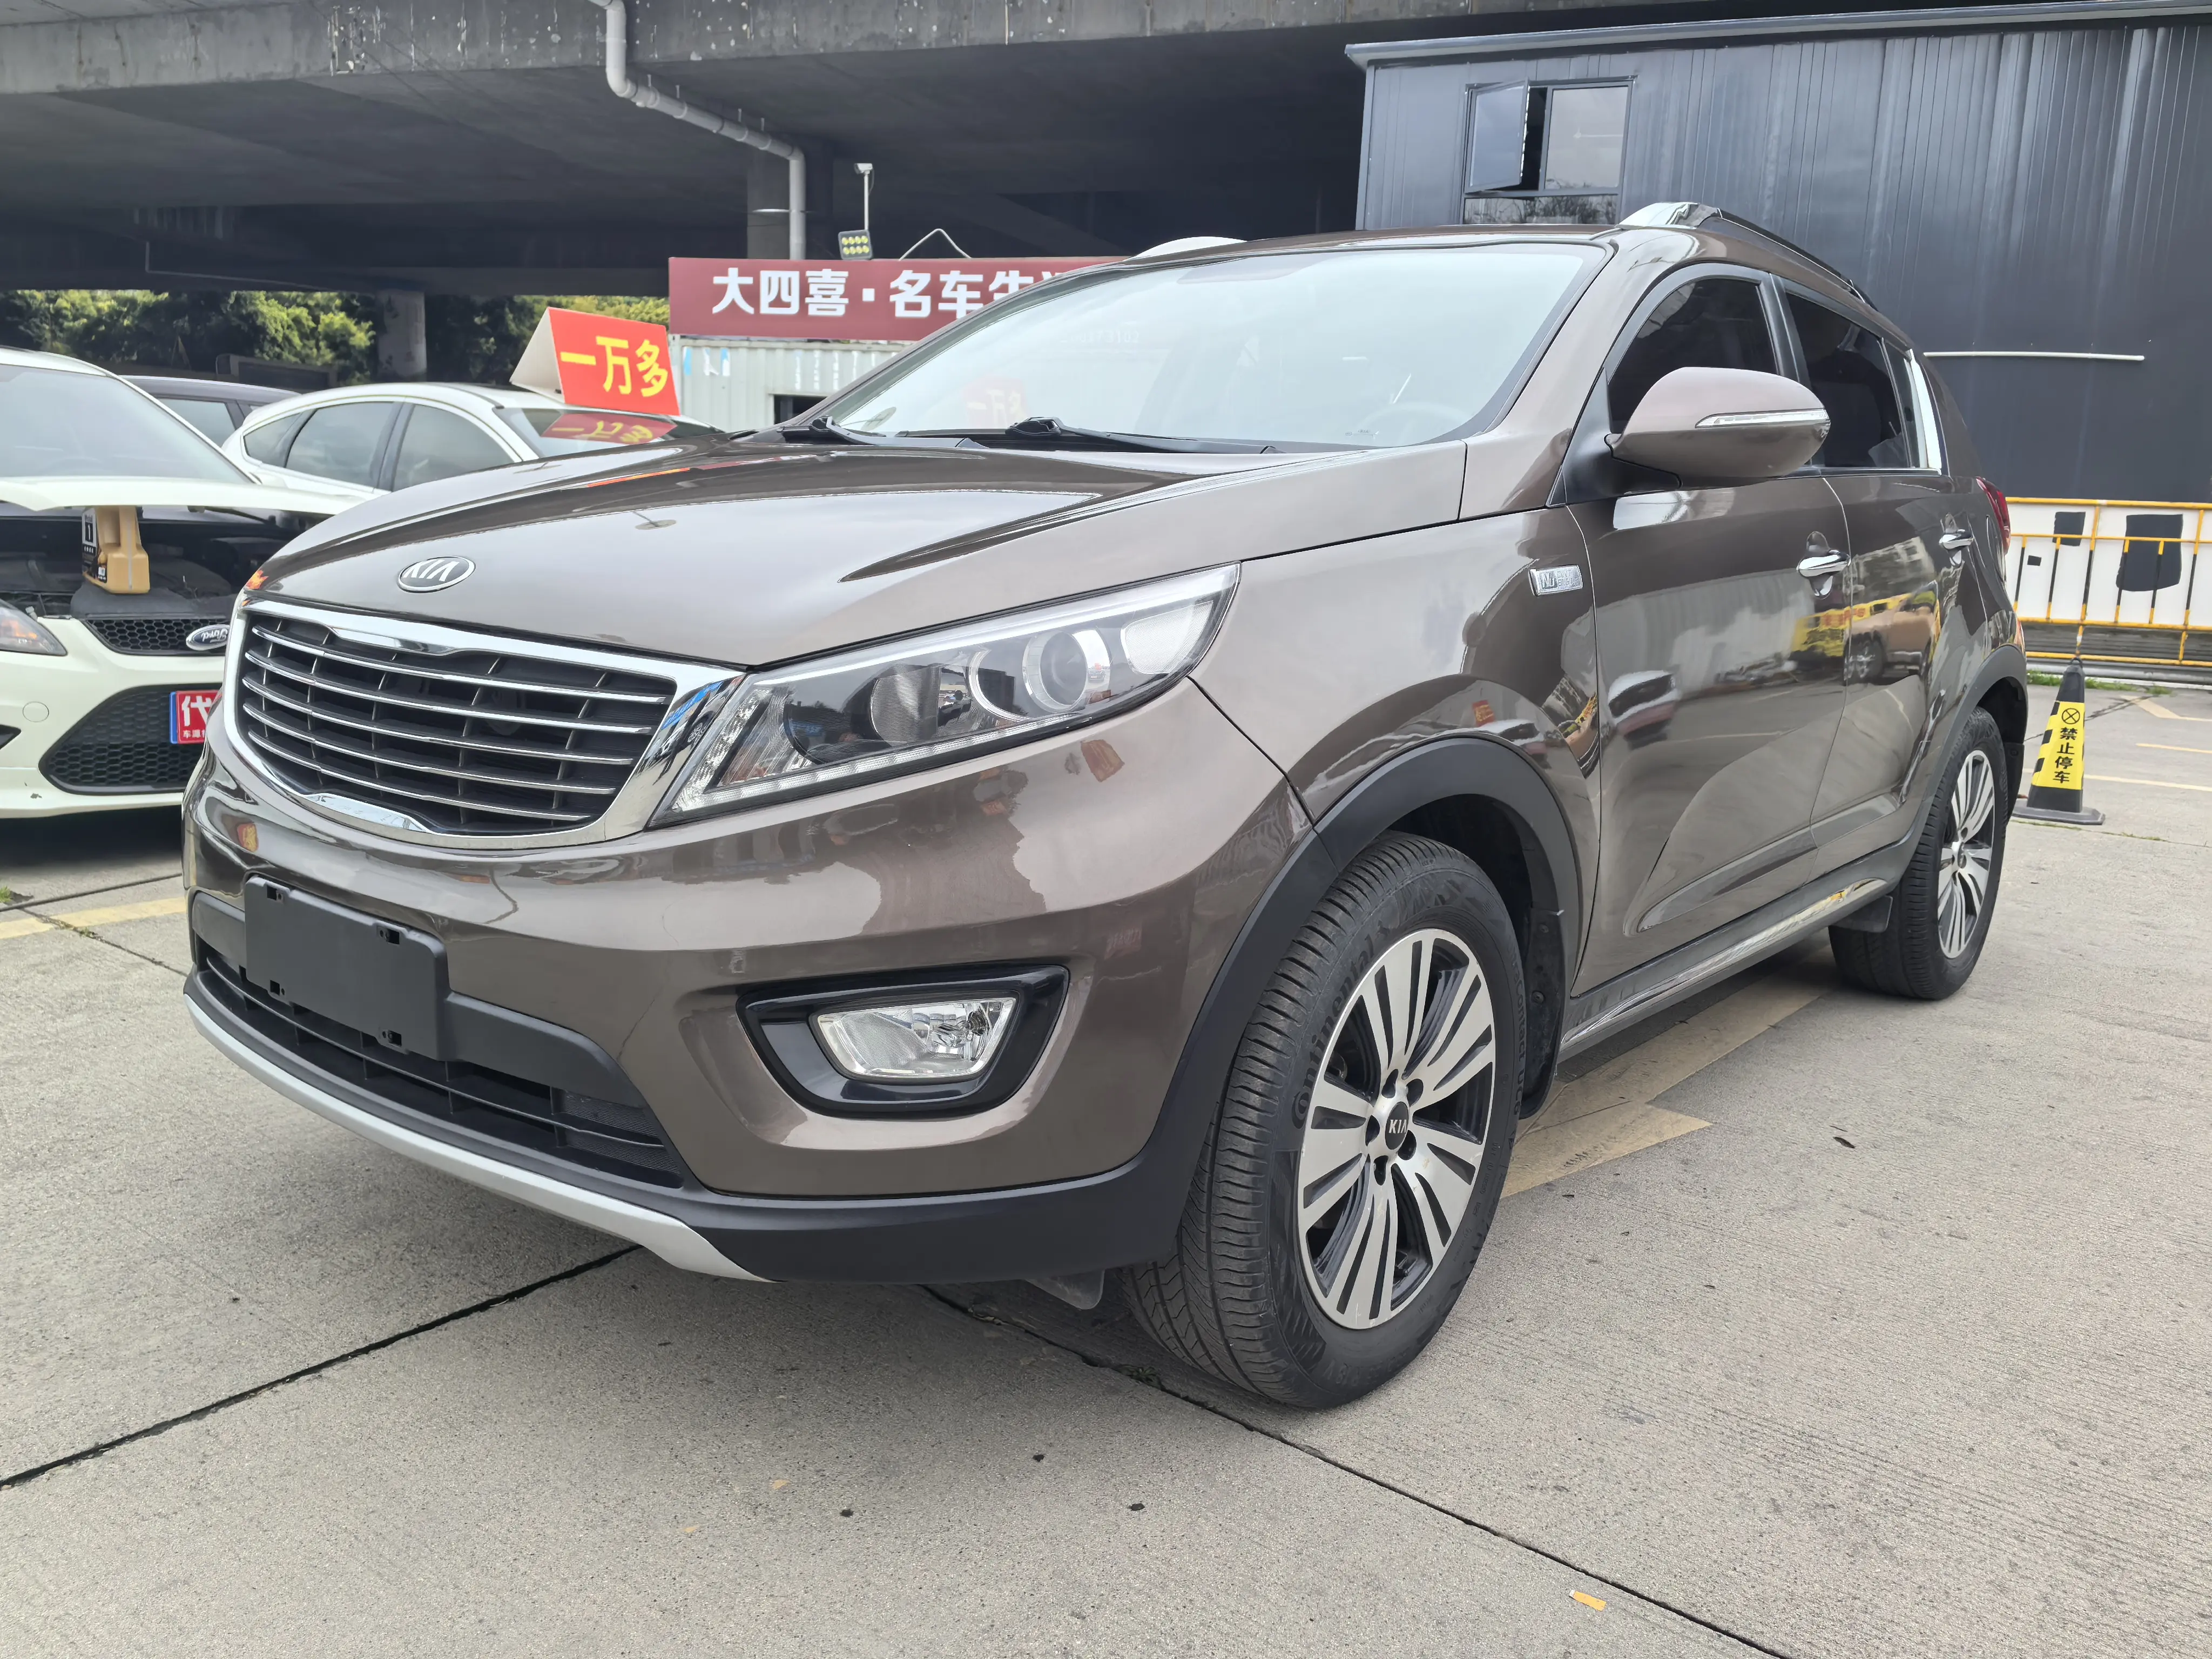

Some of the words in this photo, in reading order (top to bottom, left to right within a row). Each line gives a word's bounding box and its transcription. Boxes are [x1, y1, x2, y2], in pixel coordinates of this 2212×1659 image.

[559, 335, 669, 397] 一万多
[403, 559, 460, 582] KIA
[201, 629, 228, 643] Ford
[2053, 727, 2078, 784] 禁止停车
[1291, 933, 1375, 1129] Continental
[1388, 1119, 1407, 1134] KIA
